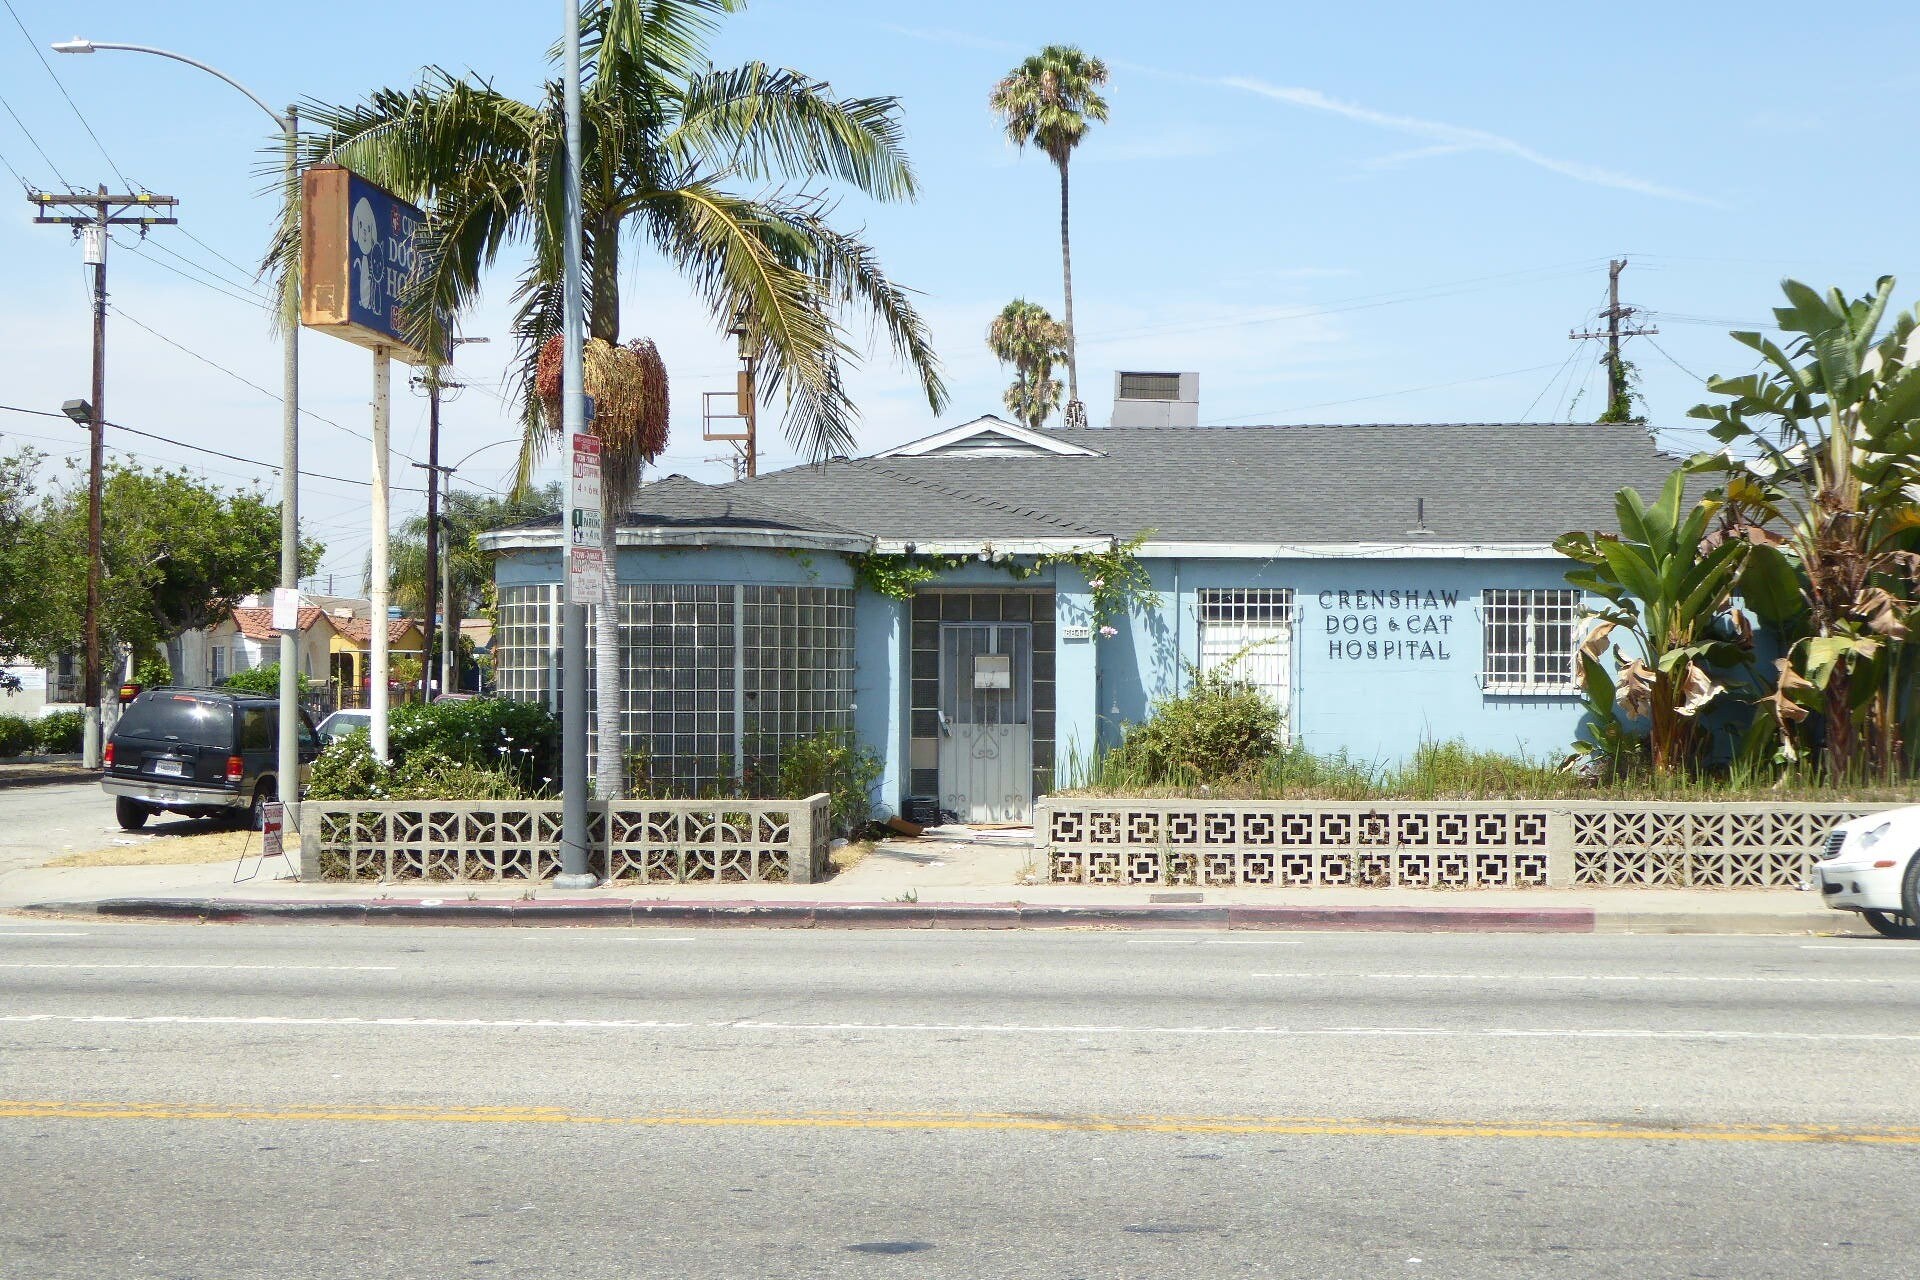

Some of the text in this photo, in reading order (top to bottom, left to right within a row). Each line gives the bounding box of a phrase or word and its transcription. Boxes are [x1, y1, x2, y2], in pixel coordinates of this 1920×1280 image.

[574, 462, 583, 478] NO
[1319, 589, 1459, 609] CRENSHAW
[1326, 615, 1453, 634] DOG & CAT
[1328, 640, 1451, 660] HOSPITAL
